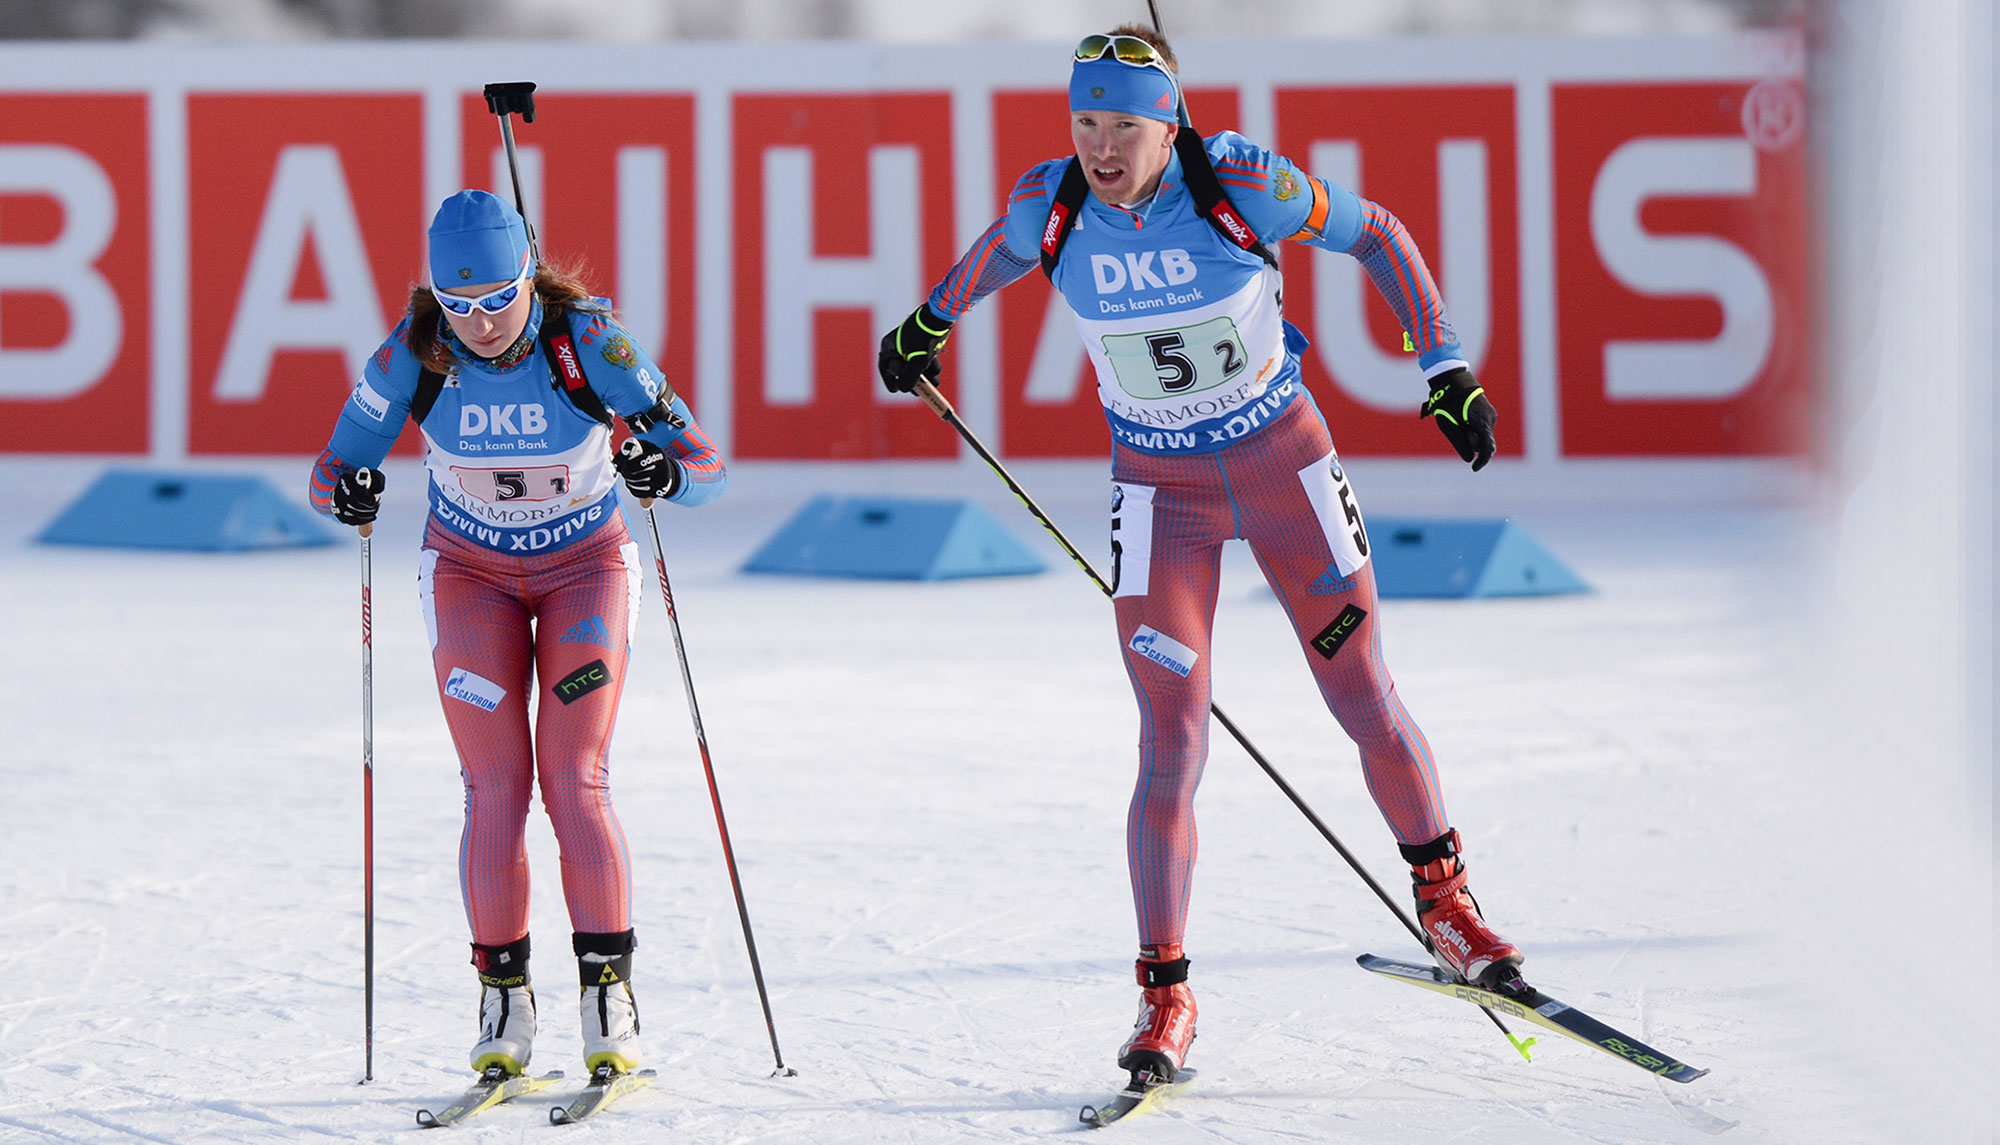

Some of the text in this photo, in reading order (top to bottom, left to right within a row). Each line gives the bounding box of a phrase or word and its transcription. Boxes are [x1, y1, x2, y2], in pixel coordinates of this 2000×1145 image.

[0, 136, 1776, 410] BAUHUS
[1090, 248, 1198, 295] DKB
[1099, 287, 1204, 314] Das kann Bank
[1144, 331, 1245, 393] 5 2
[459, 402, 549, 437] DKB
[459, 438, 549, 452] Das kann Bank
[640, 453, 665, 468] adidas
[492, 470, 565, 502] 5 1
[510, 504, 603, 551] xDrive
[1338, 483, 1368, 557] 5
[1307, 580, 1358, 597] adidas
[558, 632, 617, 652] adida
[1147, 648, 1190, 677] GAZPROM
[457, 688, 497, 711] GAZPROM
[1434, 920, 1472, 956] alpina
[479, 972, 525, 986] SCHER
[1455, 987, 1527, 1020] FISCHER
[1601, 1038, 1665, 1070] FISCHER
